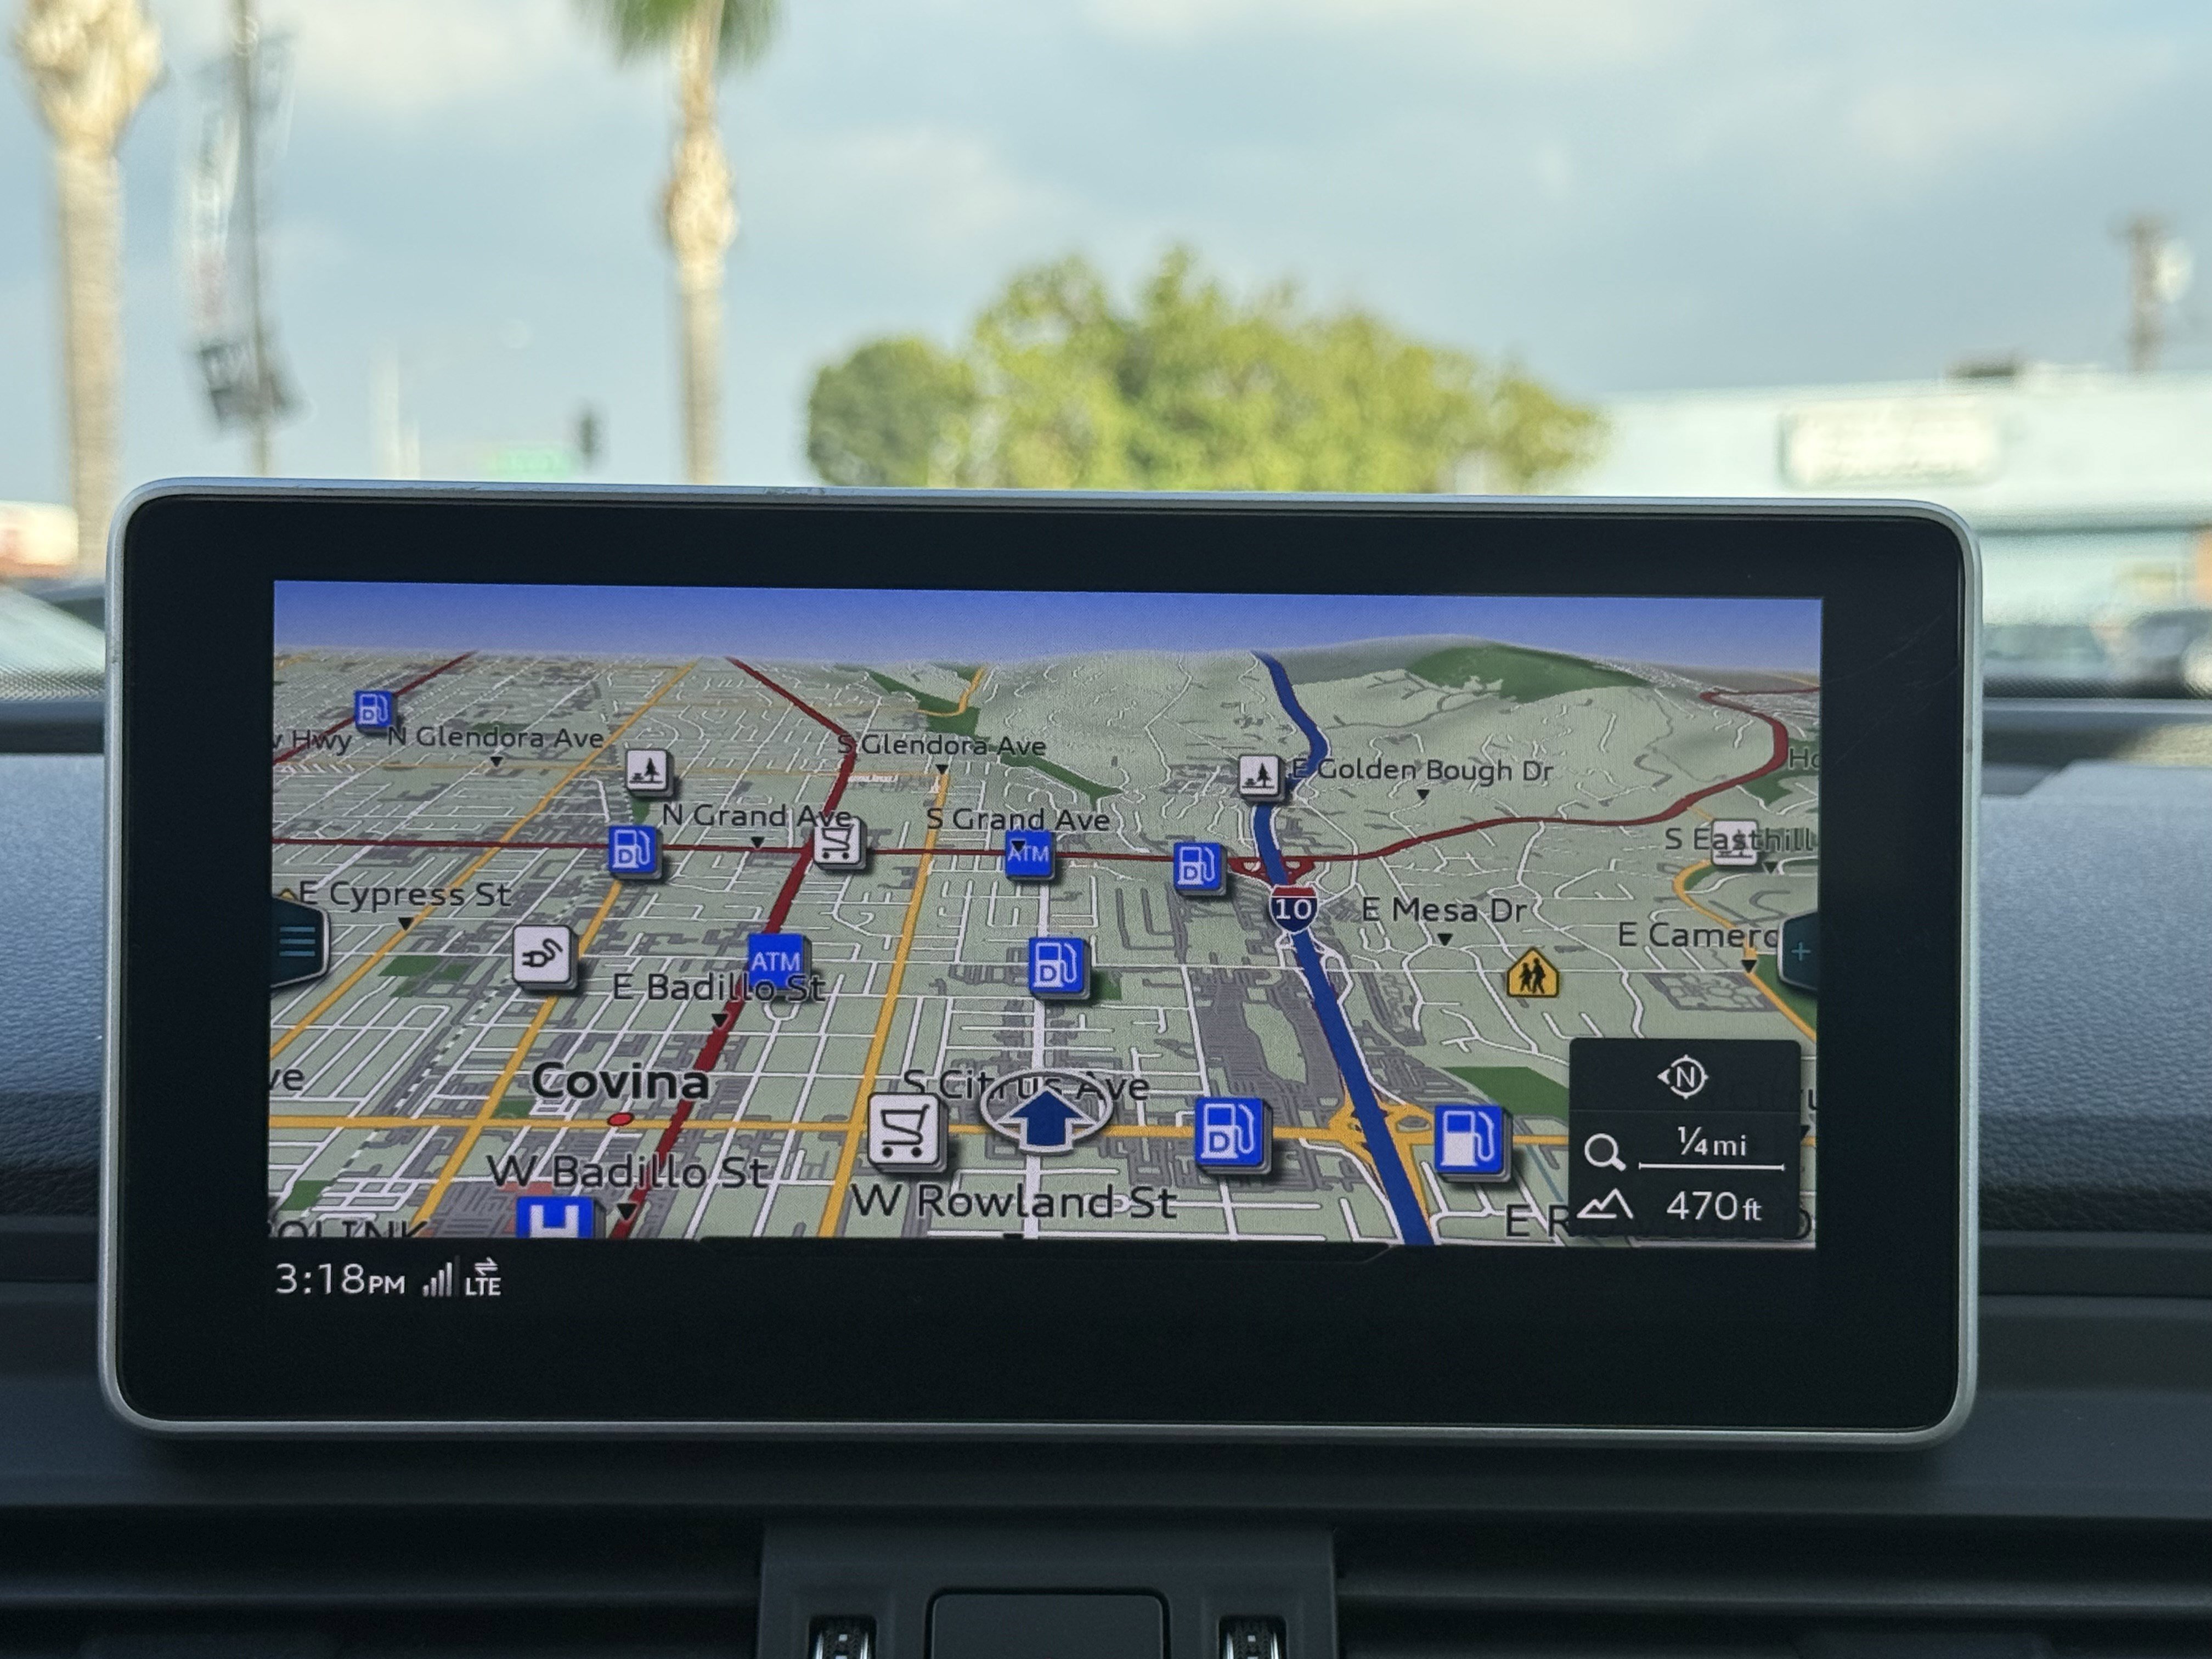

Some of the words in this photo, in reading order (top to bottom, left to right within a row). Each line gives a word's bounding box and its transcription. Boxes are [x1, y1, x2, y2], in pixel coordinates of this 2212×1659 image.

[292, 730, 352, 756] Hwy
[388, 727, 406, 745] N
[416, 727, 544, 748] Glendora
[555, 729, 604, 748] Ave
[838, 735, 854, 754] S
[861, 734, 988, 755] Glendora
[996, 736, 1046, 755] Ave
[1293, 759, 1307, 778] E
[1318, 758, 1417, 780] Golden
[1427, 759, 1512, 786] Bough
[1523, 760, 1554, 782] Dr
[663, 805, 683, 825] N
[694, 804, 786, 827] Grand
[798, 806, 851, 827] Ave
[927, 810, 943, 830] S
[953, 808, 1045, 831] Grand
[1055, 809, 1110, 831] Ave
[1664, 828, 1683, 850] S
[1694, 827, 1814, 851] Easthill
[1007, 845, 1049, 862] ATM
[300, 881, 318, 905] E
[330, 882, 465, 913] Cypress
[476, 882, 512, 906] St
[1276, 899, 1312, 921] 10
[1362, 897, 1379, 921] E
[1393, 898, 1477, 922] Mesa
[1491, 899, 1528, 923] Dr
[1618, 921, 1637, 946] E
[751, 951, 802, 972] ATM
[613, 973, 634, 1000] E
[647, 973, 775, 1002] Badillo
[788, 975, 827, 1002] St
[532, 1061, 709, 1099] Covina
[903, 1069, 926, 1093] S
[1076, 1070, 1151, 1100] Ave
[1676, 1066, 1695, 1088] N
[488, 1155, 539, 1188] W
[553, 1154, 707, 1189] Badillo
[722, 1156, 769, 1189] St
[853, 1184, 902, 1217] W
[918, 1184, 1114, 1218] Rowland
[1131, 1186, 1178, 1220] St
[1506, 1204, 1530, 1237] E
[465, 1277, 502, 1297] LTE
